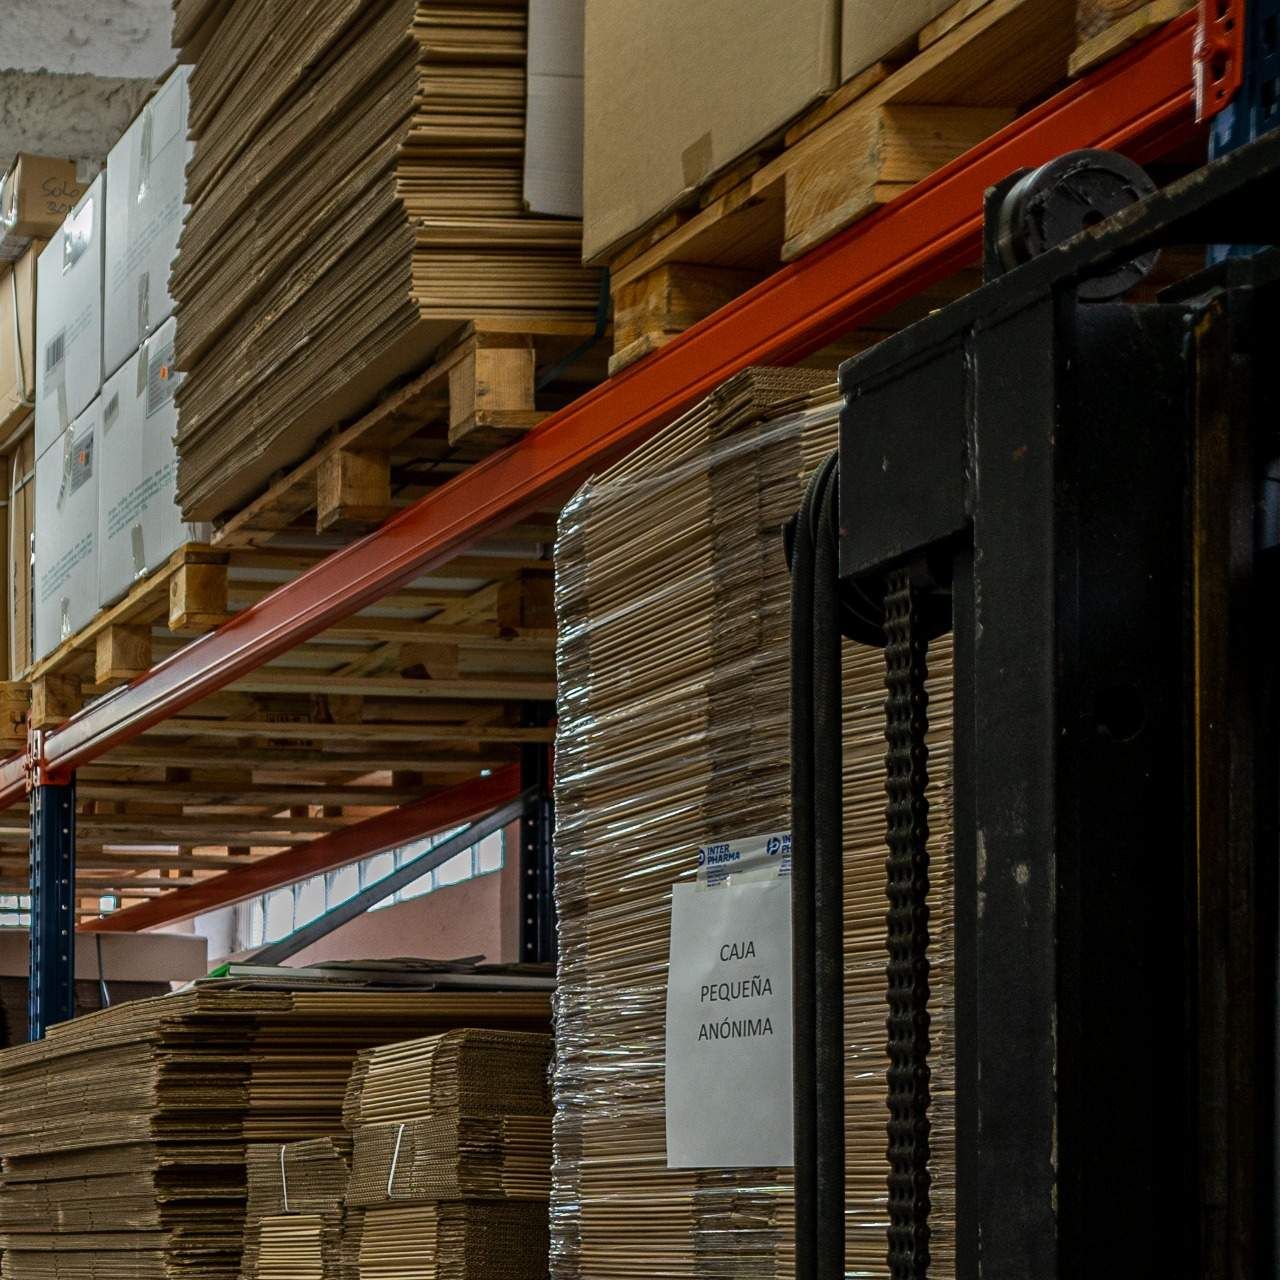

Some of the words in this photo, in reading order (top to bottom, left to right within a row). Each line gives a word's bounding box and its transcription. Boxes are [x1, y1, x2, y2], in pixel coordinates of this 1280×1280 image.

[707, 843, 730, 856] INTER
[707, 852, 740, 865] PHARMA
[719, 941, 756, 962] CAJA
[700, 975, 773, 1003] PEQUEÑA
[698, 1017, 774, 1041] ANÓNIMA
